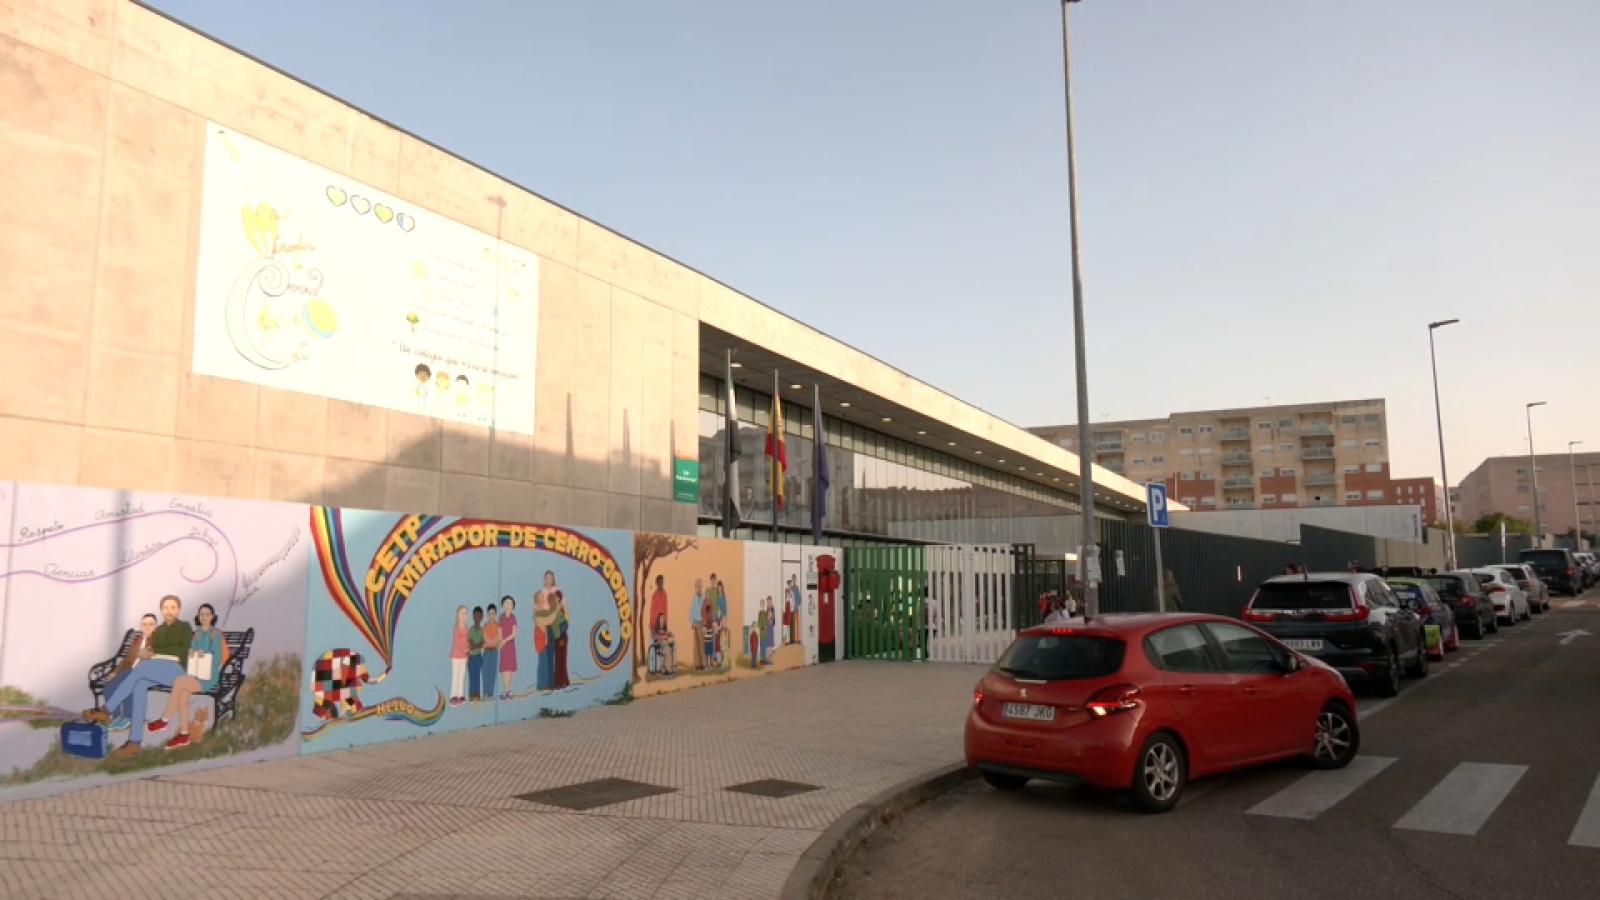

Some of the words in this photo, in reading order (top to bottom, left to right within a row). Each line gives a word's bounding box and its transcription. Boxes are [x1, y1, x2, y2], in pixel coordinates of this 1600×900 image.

[1151, 488, 1164, 521] P
[394, 524, 500, 599] MIRADOR
[509, 526, 537, 549] DE
